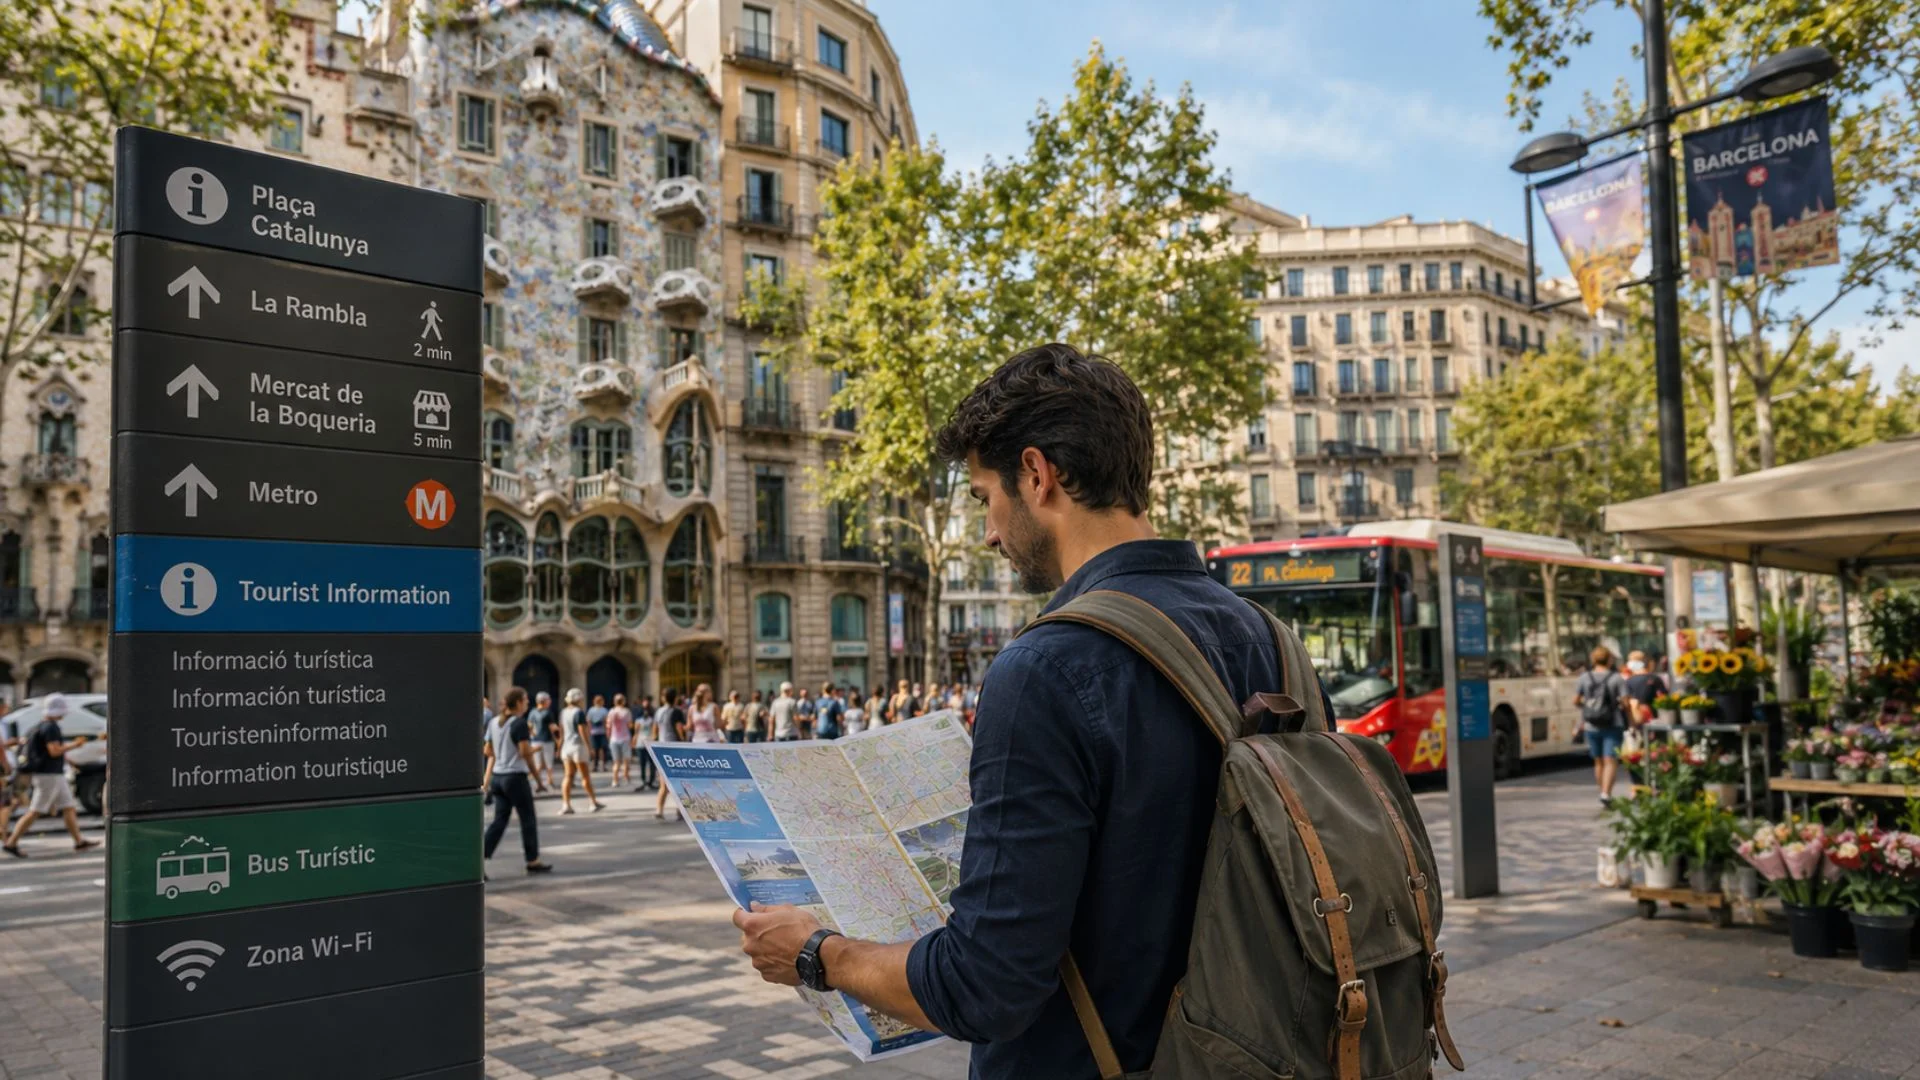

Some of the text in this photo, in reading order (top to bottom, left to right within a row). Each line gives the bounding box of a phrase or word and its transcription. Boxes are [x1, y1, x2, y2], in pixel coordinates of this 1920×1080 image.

[1693, 128, 1820, 174] BARCELONA
[252, 184, 316, 219] Plaça
[252, 215, 369, 256] Catalunya
[252, 290, 367, 327] La Rambla
[413, 343, 452, 361] 2 min
[250, 372, 363, 405] Mercat de
[250, 401, 376, 434] la Boqueria
[413, 433, 452, 450] 5 min
[249, 481, 318, 505] Metro
[415, 488, 447, 522] M
[1231, 562, 1251, 585] 22
[239, 581, 450, 605] Tourist Information
[173, 650, 374, 671] Informació turística
[172, 685, 386, 709] Información turística
[171, 722, 387, 748] Touristeninformation
[172, 756, 408, 787] Information touristique
[663, 754, 731, 769] Barcelona
[248, 843, 376, 875] Bus Turístic
[247, 932, 373, 968] Zona Wi-Fi
